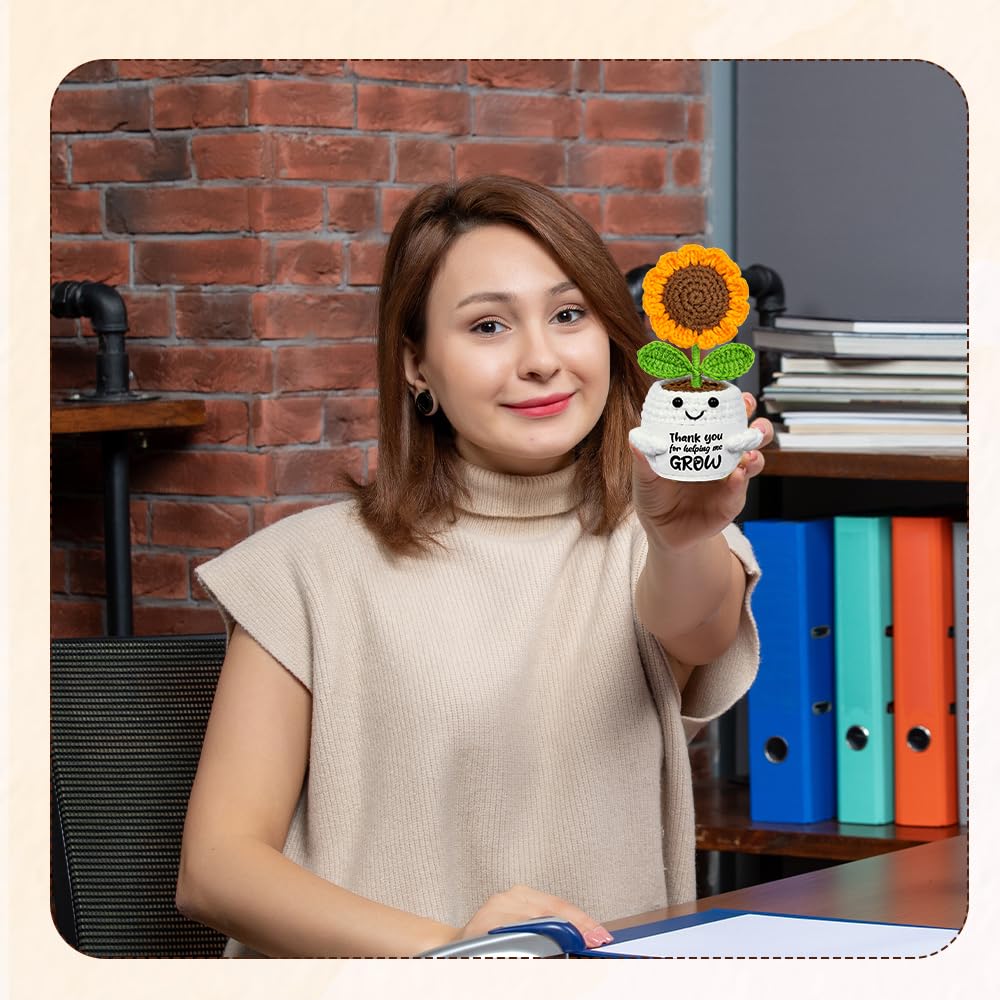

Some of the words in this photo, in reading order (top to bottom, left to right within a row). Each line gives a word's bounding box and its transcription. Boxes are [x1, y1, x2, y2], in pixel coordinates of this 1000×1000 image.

[669, 431, 701, 443] Thank
[704, 433, 723, 444] you
[669, 443, 681, 454] for
[683, 444, 710, 455] helping
[670, 454, 722, 471] GROW
